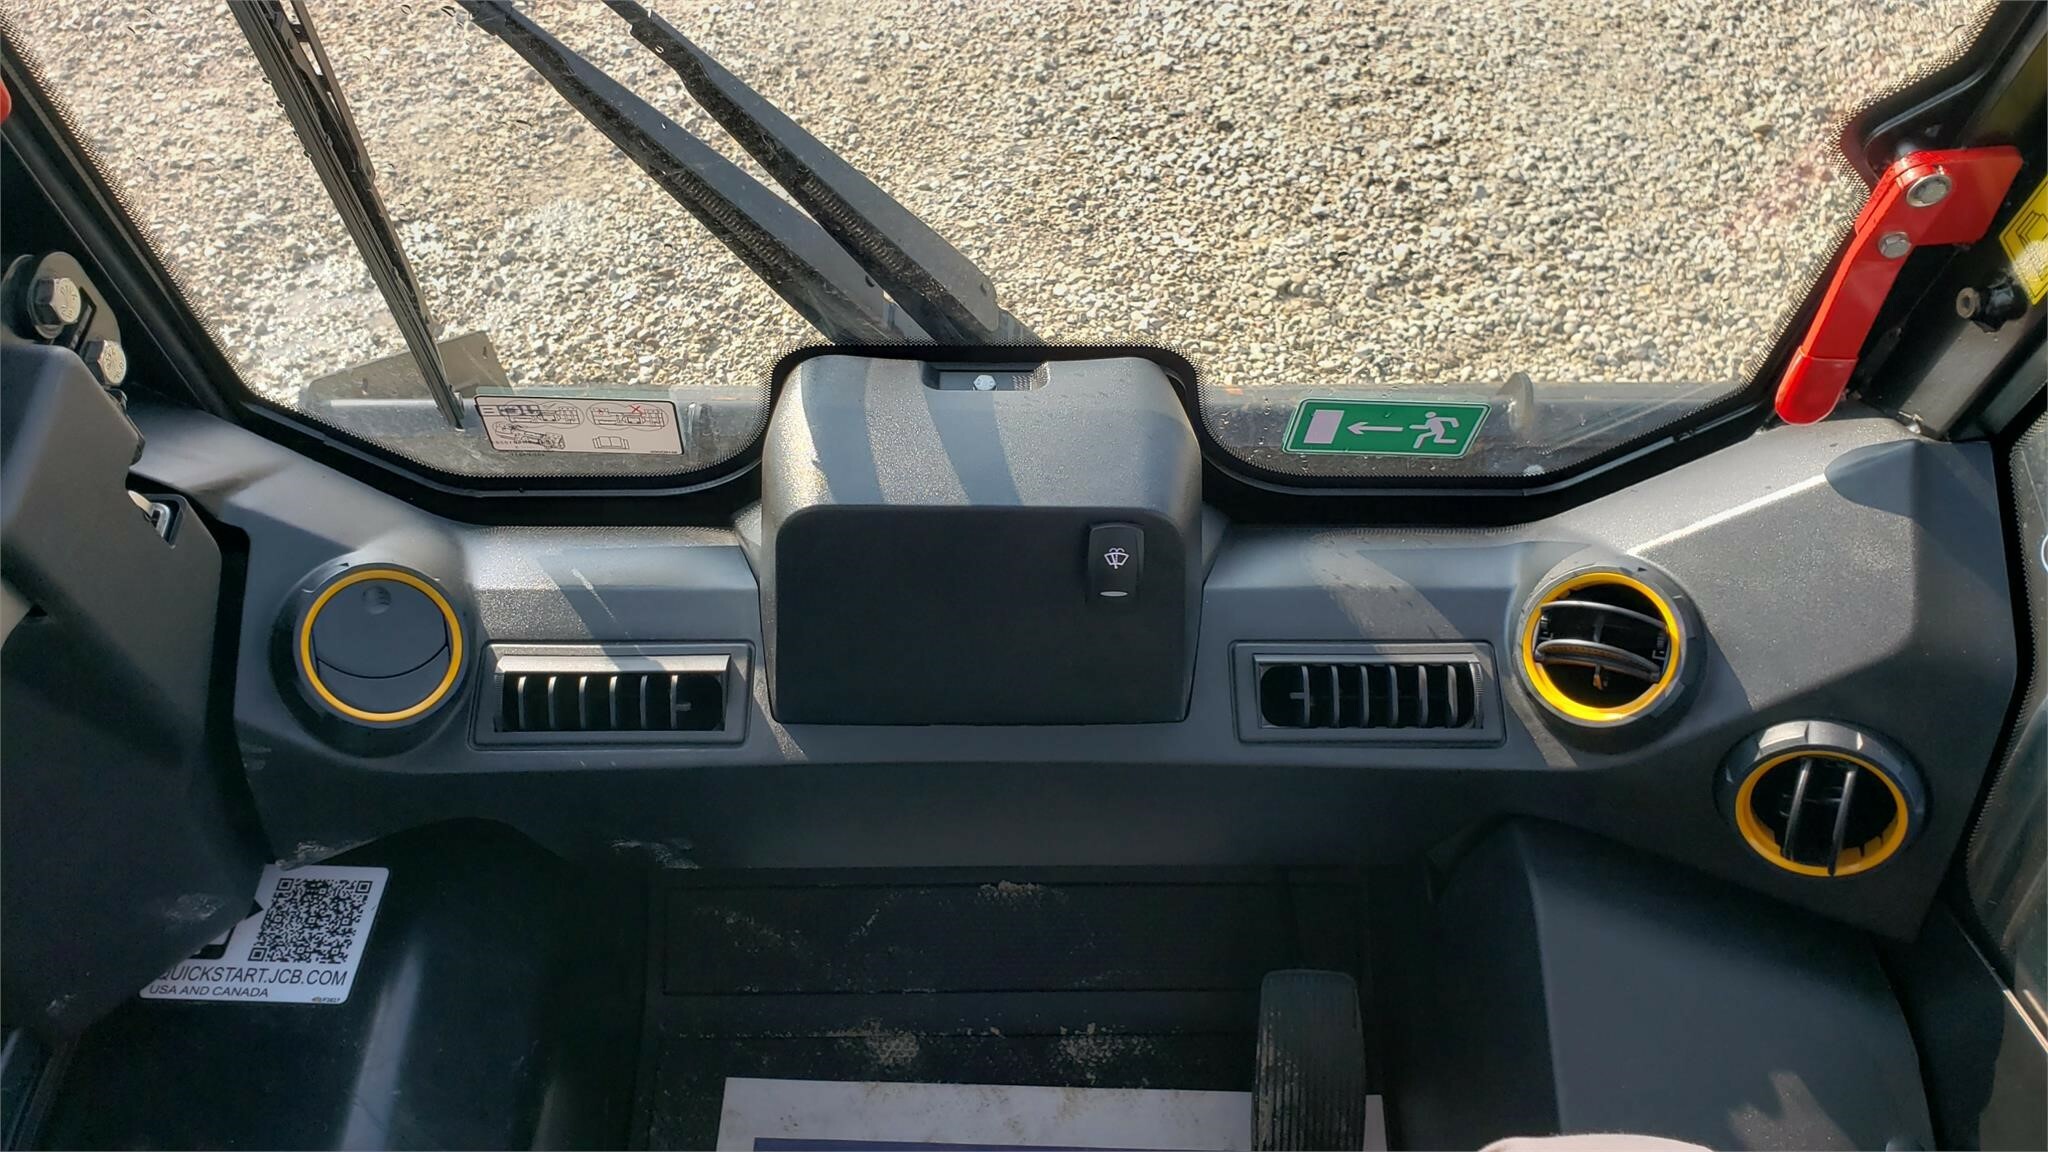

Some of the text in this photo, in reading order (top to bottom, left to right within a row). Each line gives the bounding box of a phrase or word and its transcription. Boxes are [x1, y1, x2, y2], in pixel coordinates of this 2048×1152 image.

[149, 984, 269, 998] USA AND CANADA
